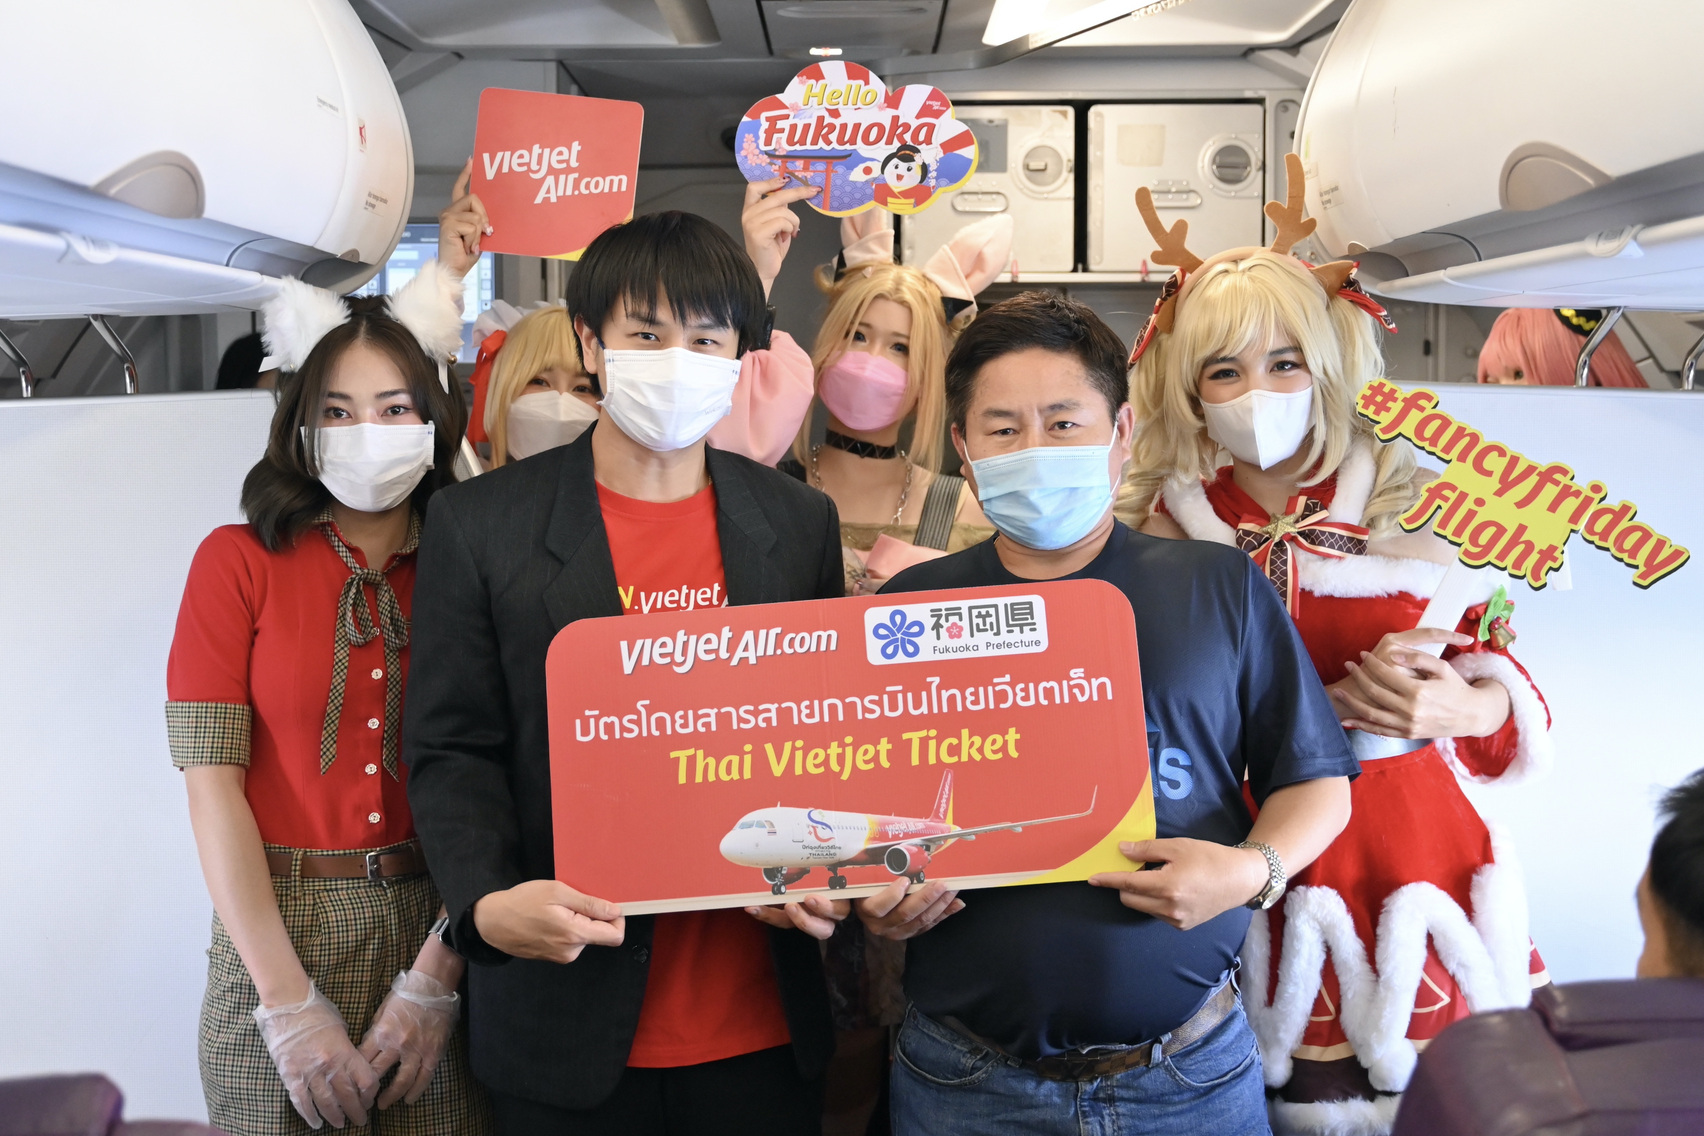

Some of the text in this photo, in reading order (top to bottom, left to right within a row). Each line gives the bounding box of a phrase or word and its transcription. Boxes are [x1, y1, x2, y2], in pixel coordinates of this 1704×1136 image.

[802, 83, 878, 107] Hello
[763, 114, 937, 147] Fukuoka
[533, 172, 628, 204] Air.com
[1359, 381, 1686, 582] #fancyfriday
[1402, 481, 1561, 584] flight
[929, 600, 1038, 641] 福岡県
[932, 638, 1042, 655] Fukuoka Prefecture
[574, 667, 1114, 743] บัตรโดยสารสายการบินไทยเวียตเจ็ท
[669, 726, 1021, 785] Thai Vietjet Ticket
